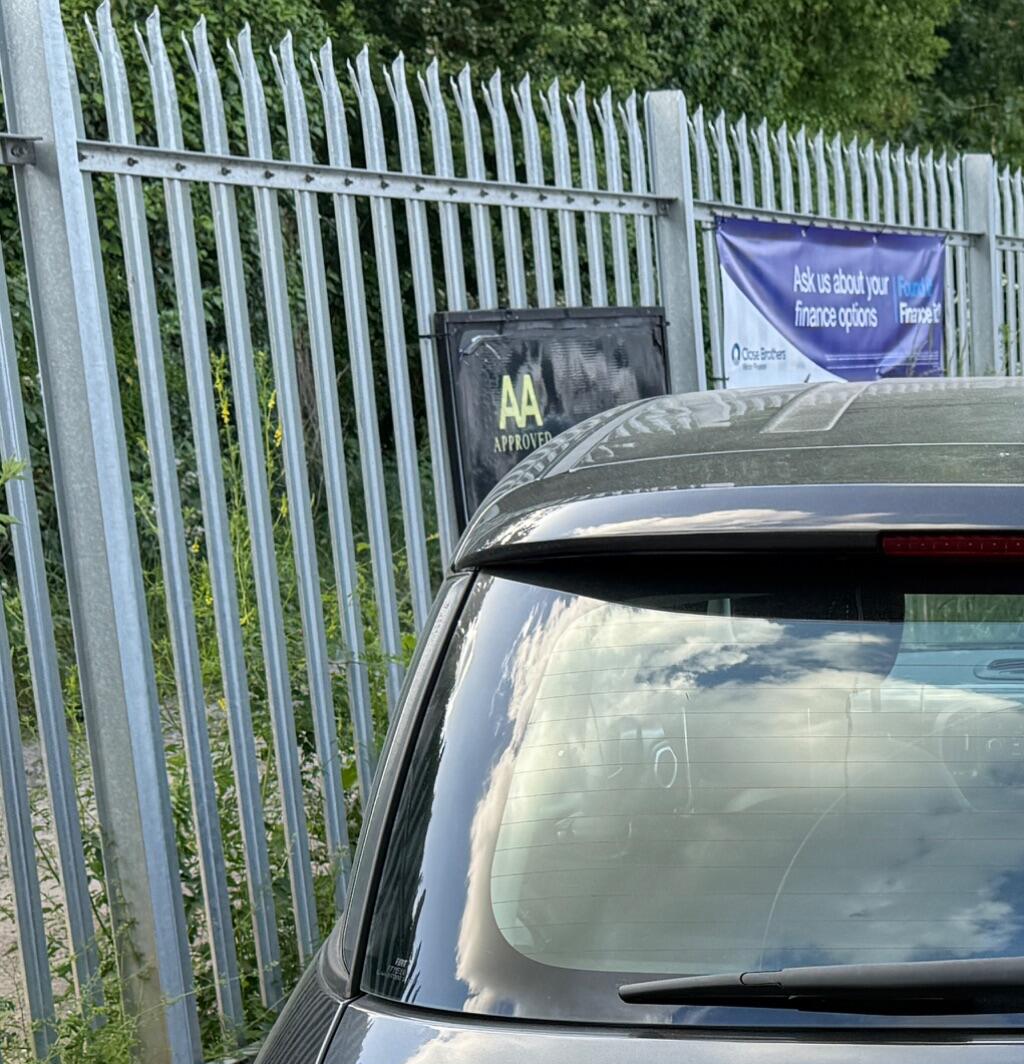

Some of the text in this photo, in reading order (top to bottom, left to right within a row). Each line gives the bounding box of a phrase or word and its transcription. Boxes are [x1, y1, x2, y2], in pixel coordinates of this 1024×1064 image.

[793, 264, 889, 301] Ask us about your
[795, 300, 878, 333] finance options
[499, 374, 544, 430] AA
